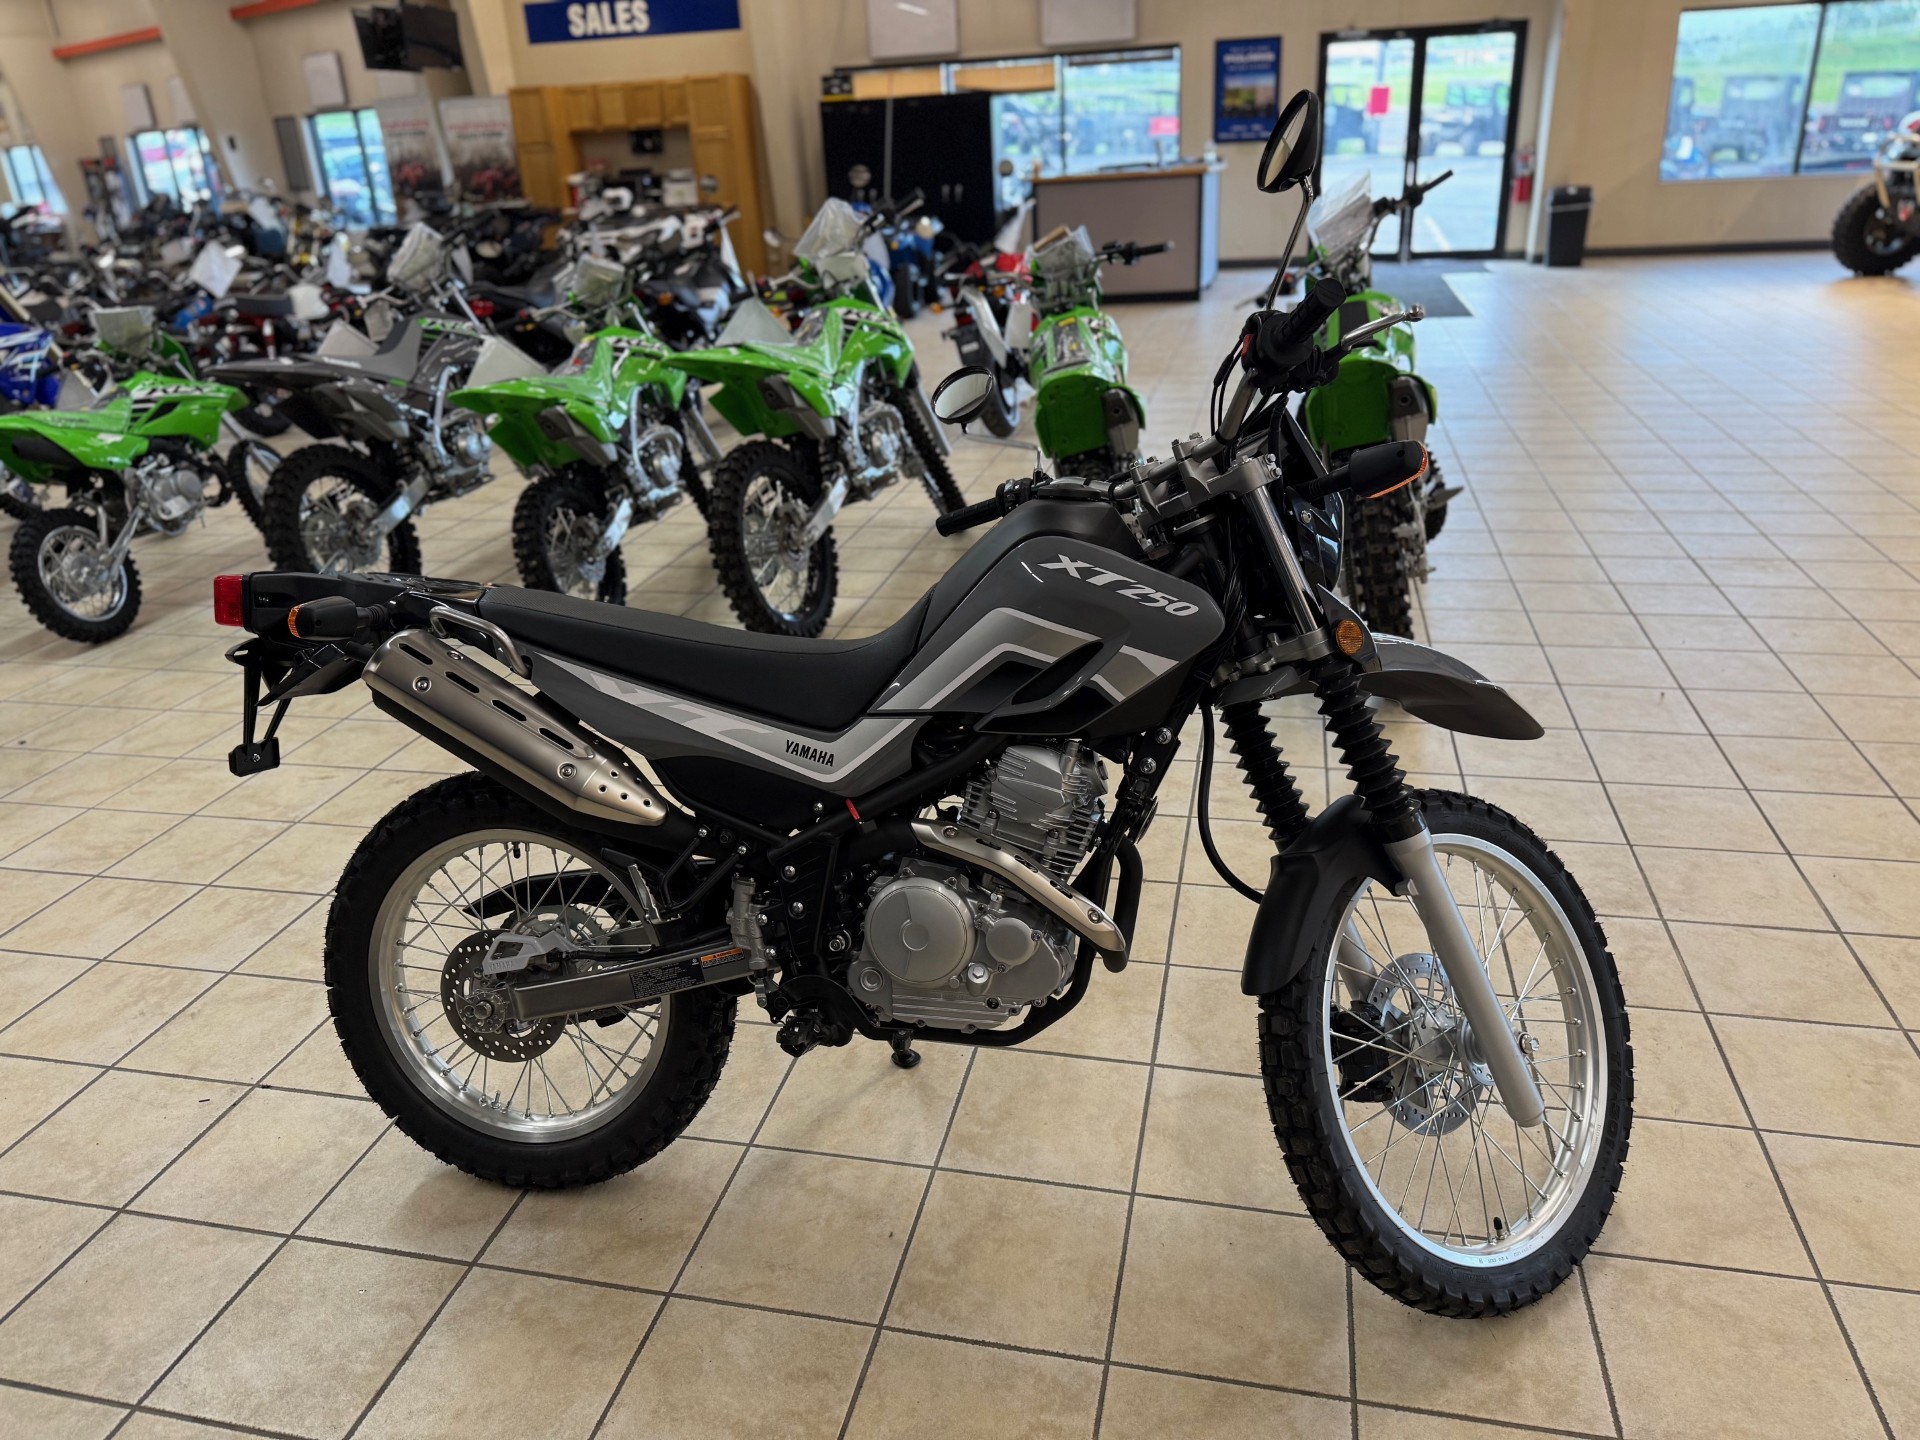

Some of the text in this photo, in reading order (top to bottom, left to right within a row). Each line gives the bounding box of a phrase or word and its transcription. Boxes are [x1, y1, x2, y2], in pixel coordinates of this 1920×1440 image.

[567, 0, 650, 38] SALES
[1037, 553, 1200, 617] XT250
[785, 739, 835, 767] YAMAHA
